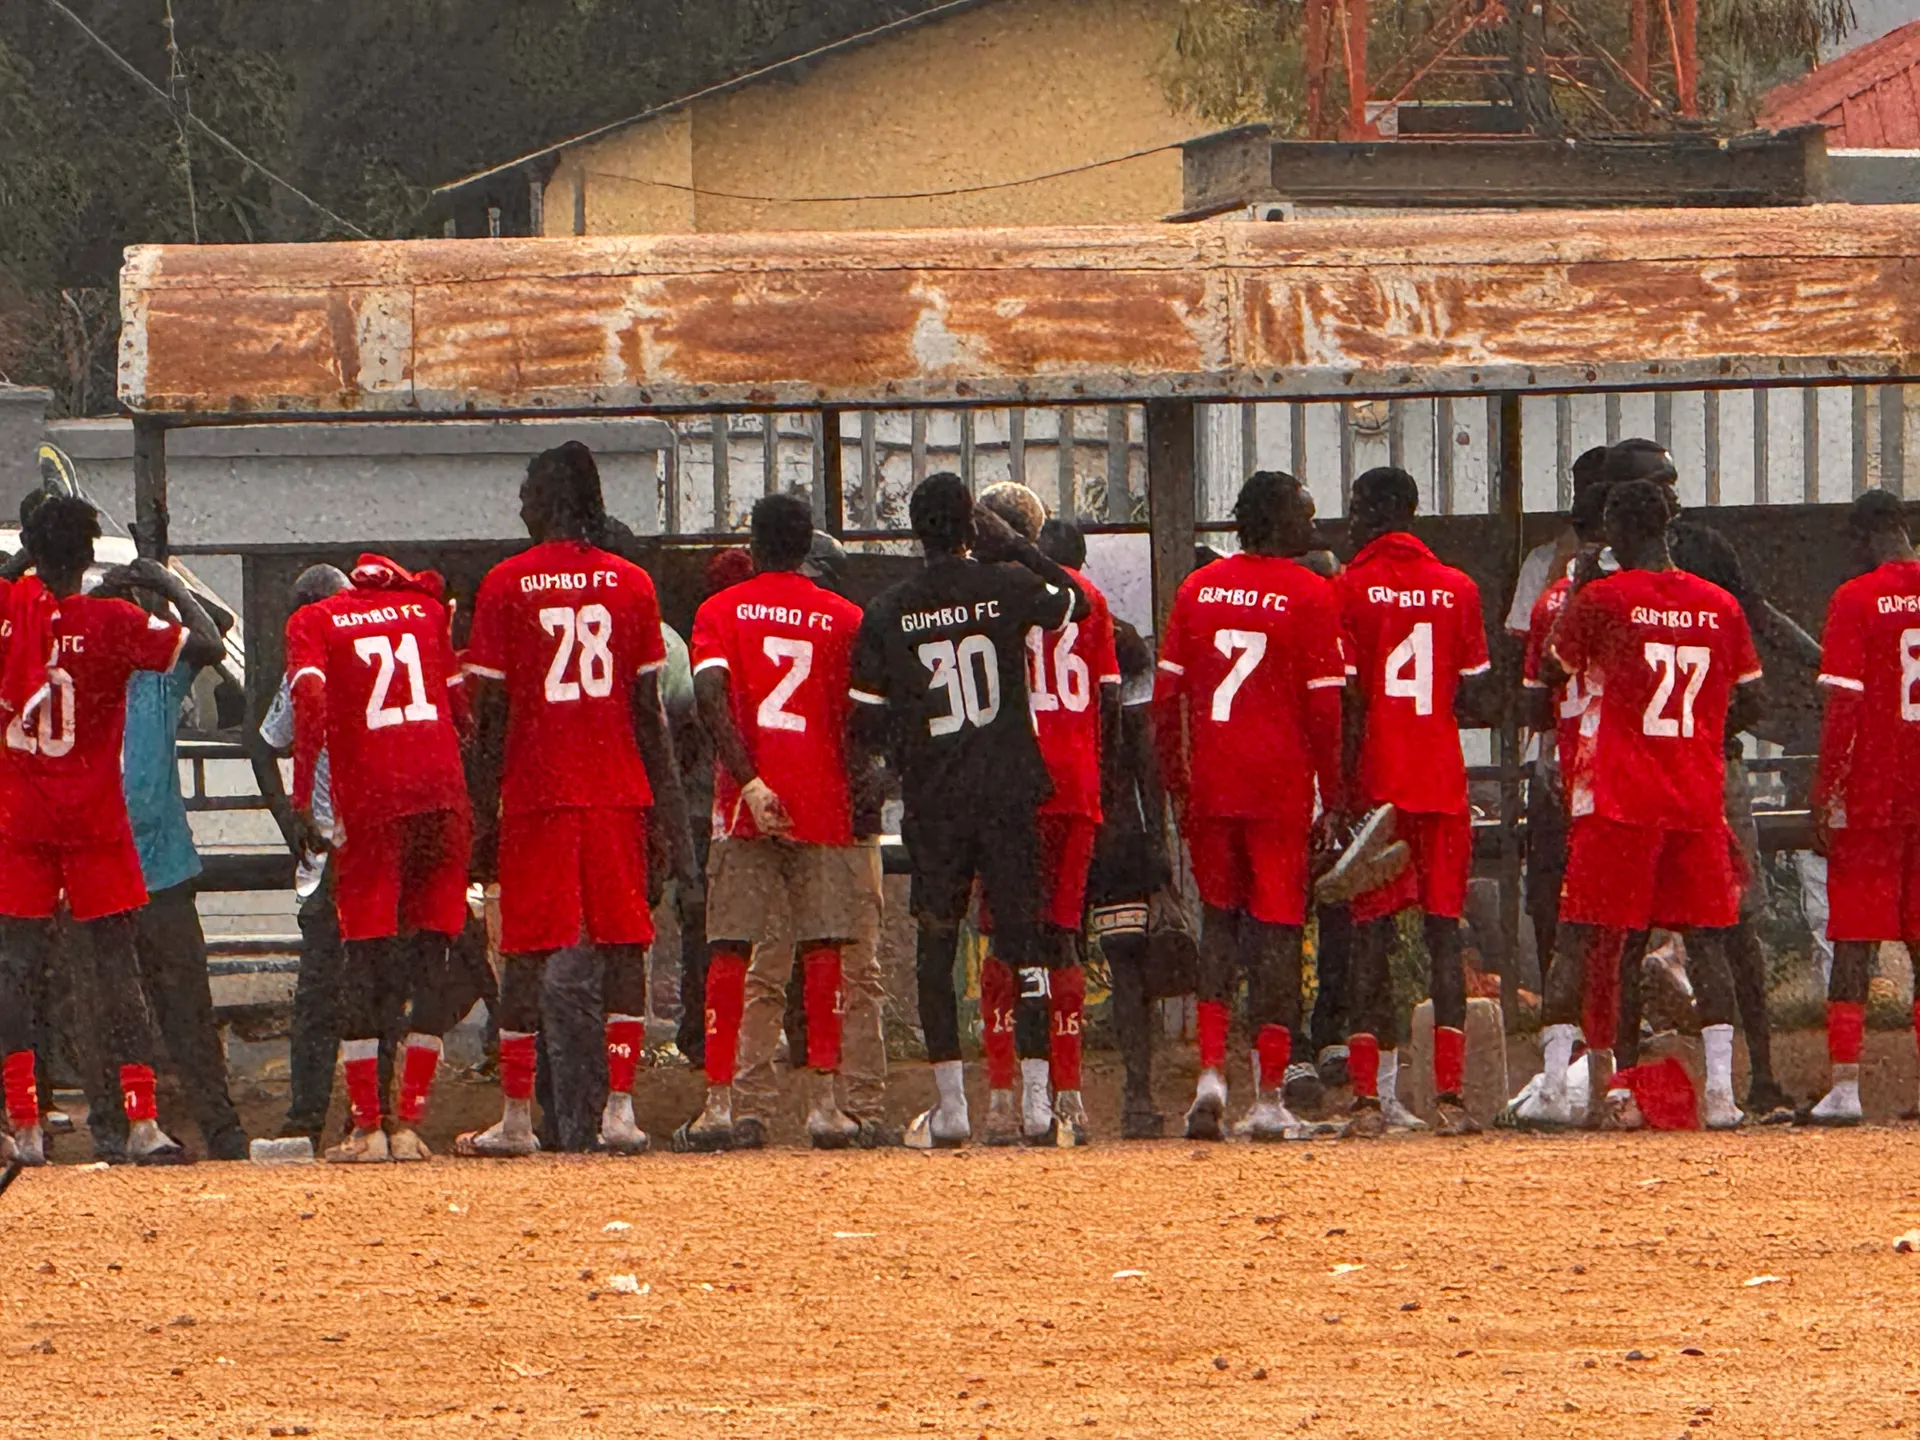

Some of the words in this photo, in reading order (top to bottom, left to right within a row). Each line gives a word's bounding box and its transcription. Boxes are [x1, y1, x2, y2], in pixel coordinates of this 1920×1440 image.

[521, 573, 587, 593] GUMBO
[593, 571, 618, 588] FC
[401, 604, 427, 619] FC
[1198, 586, 1258, 606] GUMBO
[1262, 592, 1289, 611] FC
[1432, 589, 1455, 608] FC
[1877, 595, 1920, 614] GUMB
[736, 603, 802, 626] GUMBO
[808, 611, 834, 631] FC
[901, 606, 968, 632] GUMBO
[974, 600, 1001, 621] FC
[1631, 606, 1692, 628] GUMBO
[1697, 610, 1719, 629] FC
[61, 635, 85, 653] FC
[538, 604, 613, 702] 28
[1025, 622, 1090, 712] 16
[1211, 629, 1267, 722] 7
[1385, 622, 1433, 716] 4
[353, 633, 438, 731] 21
[757, 636, 813, 732] 2
[918, 634, 1001, 737] 30
[1643, 642, 1710, 738] 27
[993, 1007, 1016, 1034] 16
[1055, 1010, 1080, 1036] 16
